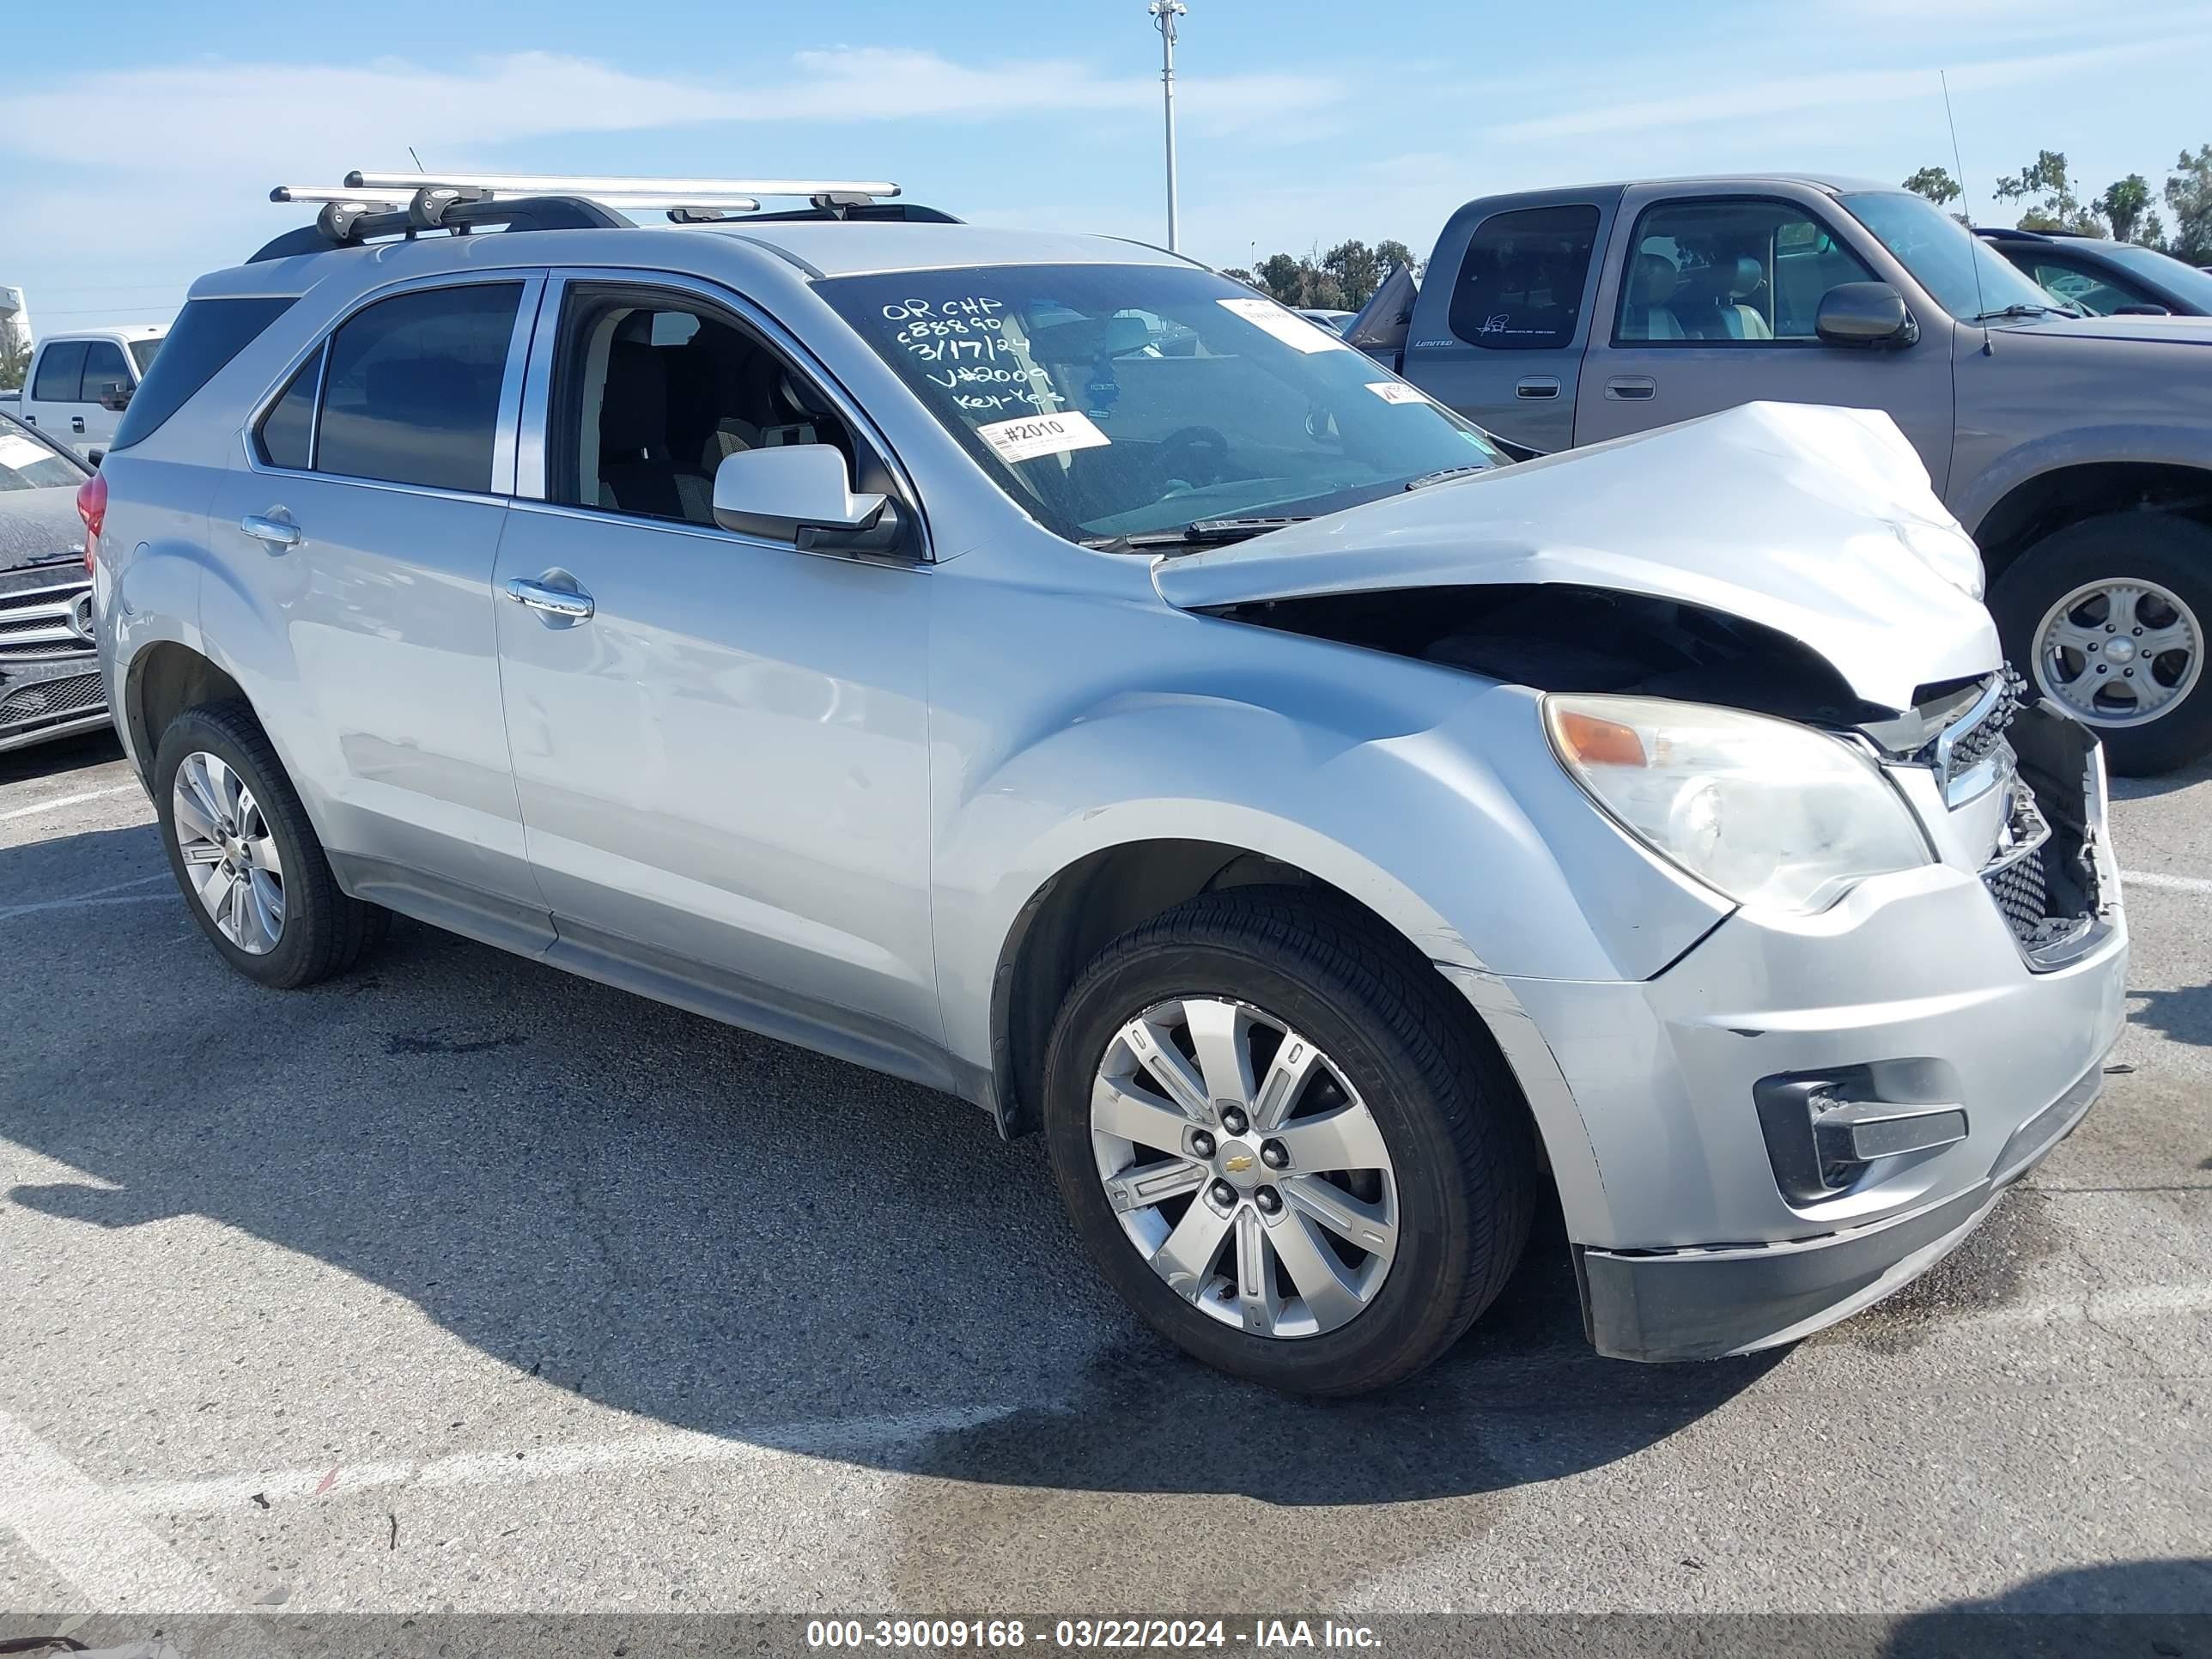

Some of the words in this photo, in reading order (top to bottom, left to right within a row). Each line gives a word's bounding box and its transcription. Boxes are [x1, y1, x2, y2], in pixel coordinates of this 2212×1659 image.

[883, 298, 938, 320] OR
[942, 297, 1003, 315] CHP
[908, 335, 1030, 361] 3/17/24
[1005, 421, 1065, 442] #2010
